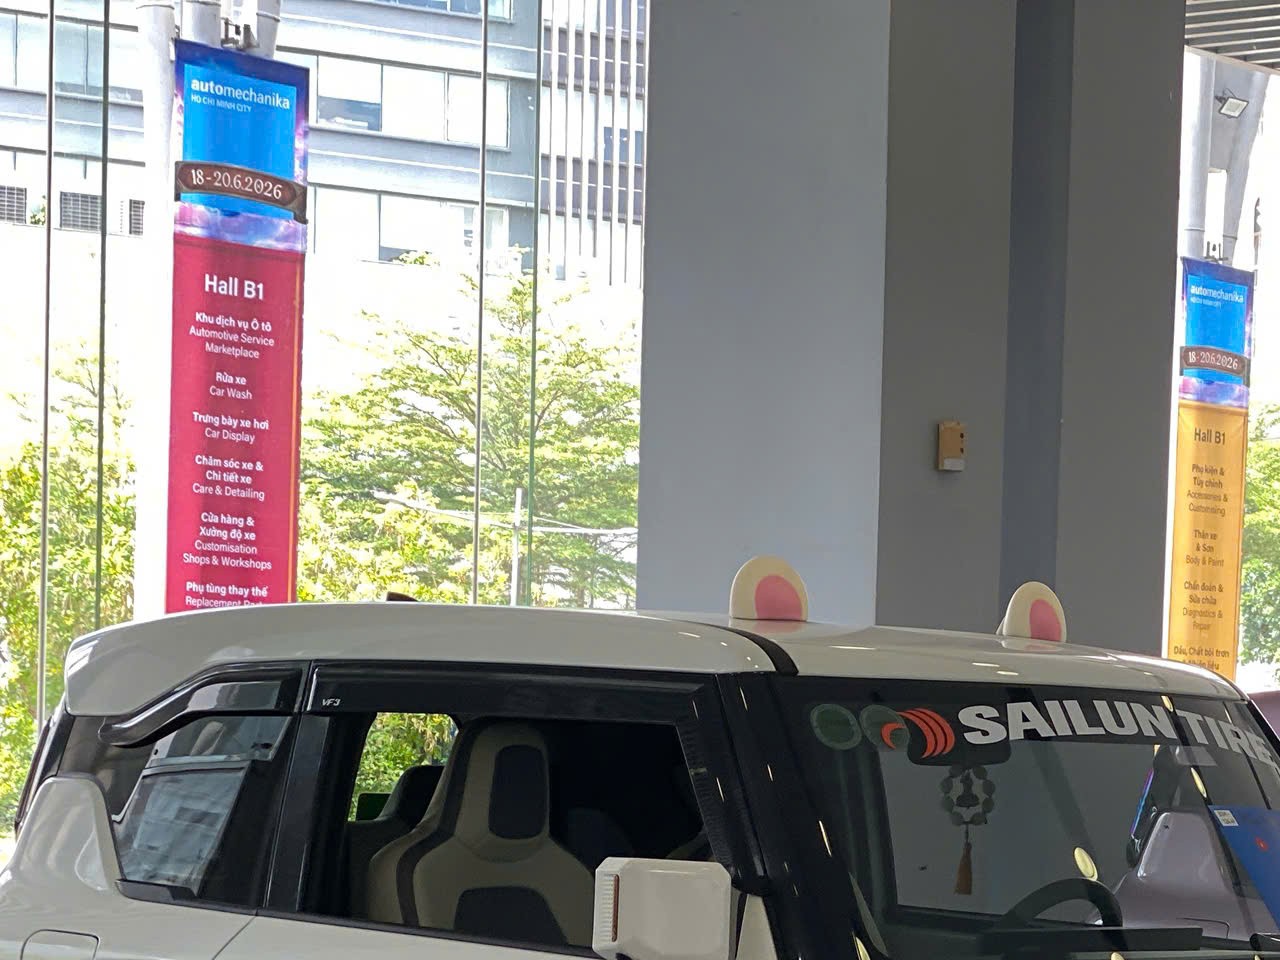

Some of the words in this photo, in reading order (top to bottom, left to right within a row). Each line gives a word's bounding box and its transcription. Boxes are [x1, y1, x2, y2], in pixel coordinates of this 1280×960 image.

[190, 79, 291, 110] automechanika
[191, 94, 201, 104] HO
[202, 96, 215, 106] CHI
[216, 99, 236, 110] MINH
[236, 103, 252, 113] CITY
[191, 169, 283, 199] 18-20.6.2026
[205, 274, 238, 296] Hall
[244, 280, 264, 300] B1
[1190, 285, 1244, 303] automechanika
[195, 312, 214, 324] Khu
[215, 315, 235, 328] dịch
[237, 321, 249, 331] vụ
[251, 318, 259, 331] Ô
[261, 322, 272, 332] tô
[189, 325, 239, 342] Automotive
[240, 333, 275, 347] Service
[205, 342, 260, 359] Marketplace
[216, 371, 233, 384] Rửa
[235, 376, 247, 385] xe
[209, 385, 225, 397] Car
[226, 387, 253, 400] Wash
[192, 411, 220, 426] Trưng
[221, 414, 238, 429] bày
[240, 420, 251, 429] xe
[253, 418, 269, 430] hơi
[204, 427, 221, 438] Car
[222, 429, 255, 445] Display
[1193, 427, 1212, 443] Hall
[1214, 431, 1226, 445] B1
[195, 454, 221, 467] Chăm
[223, 458, 240, 469] sóc
[241, 461, 253, 470] xe
[255, 461, 264, 472] &
[1219, 467, 1225, 476] &
[205, 470, 221, 481] Chi
[222, 471, 239, 483] tiết
[240, 476, 252, 485] xe
[192, 482, 214, 494] Care
[214, 485, 223, 496] &
[224, 486, 265, 502] Detailing
[200, 511, 219, 523] Cửa
[220, 513, 244, 527] hàng
[246, 517, 255, 526] &
[230, 529, 242, 541] độ
[244, 532, 256, 541] xe
[194, 539, 258, 554] Customisation
[183, 553, 210, 566] Shops
[211, 556, 219, 566] &
[220, 557, 272, 571] Workshops
[186, 581, 204, 595] Phụ
[206, 582, 226, 596] tùng
[228, 584, 249, 598] thay
[251, 586, 268, 598] thế
[185, 595, 242, 608] Replacement
[322, 698, 341, 706] VF3
[957, 699, 1178, 746] SAILUN
